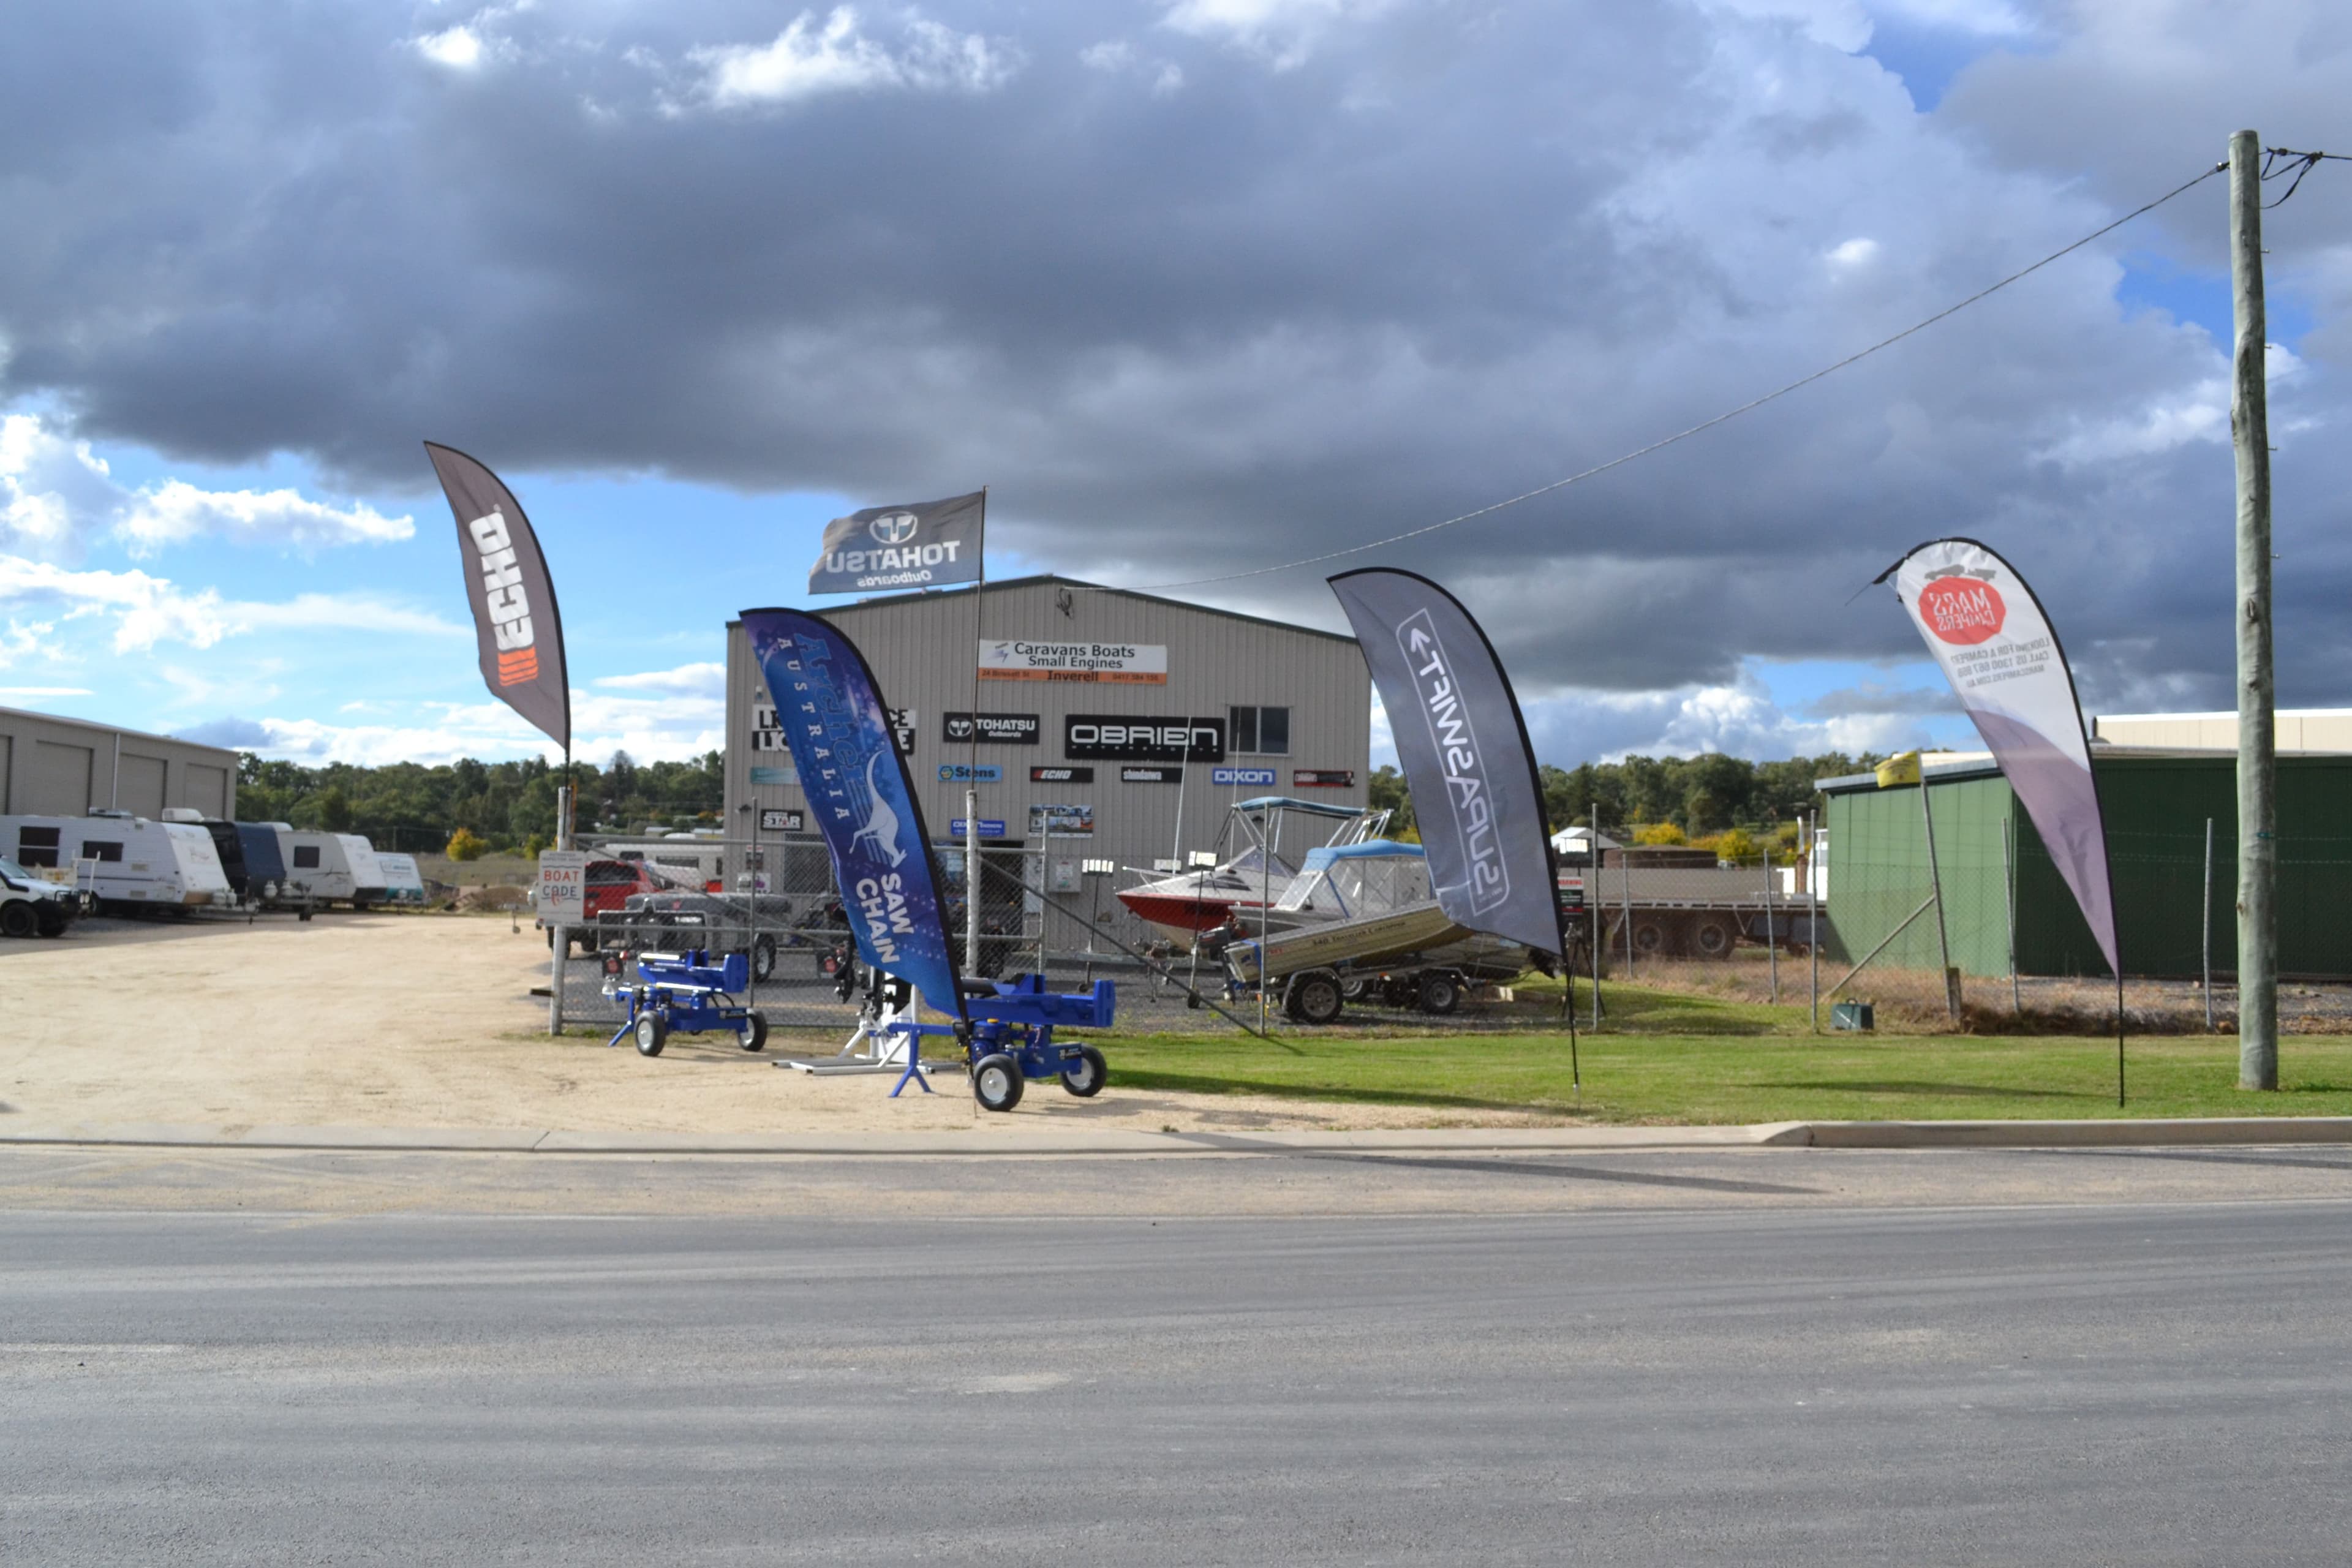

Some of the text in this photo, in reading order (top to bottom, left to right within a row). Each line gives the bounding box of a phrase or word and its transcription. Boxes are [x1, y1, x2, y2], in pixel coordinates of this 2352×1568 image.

[469, 511, 534, 651] ECHO
[1014, 642, 1087, 656] Caravans
[1092, 644, 1136, 658] Boats
[1028, 655, 1123, 670] Small Engines
[1048, 671, 1098, 682] Inverell
[793, 632, 867, 787] Archer
[777, 637, 850, 820] AUSTRALIA
[975, 718, 1035, 731] TOHATSU
[1071, 725, 1218, 747] OBRIEN
[955, 766, 995, 778] Stens
[1041, 770, 1072, 780] ECHO
[1214, 770, 1273, 783] DIXON
[763, 815, 801, 826] STAR
[543, 869, 579, 882] BOAT
[542, 885, 577, 897] CODE
[880, 872, 915, 934] SAW
[856, 878, 900, 963] CHAIN
